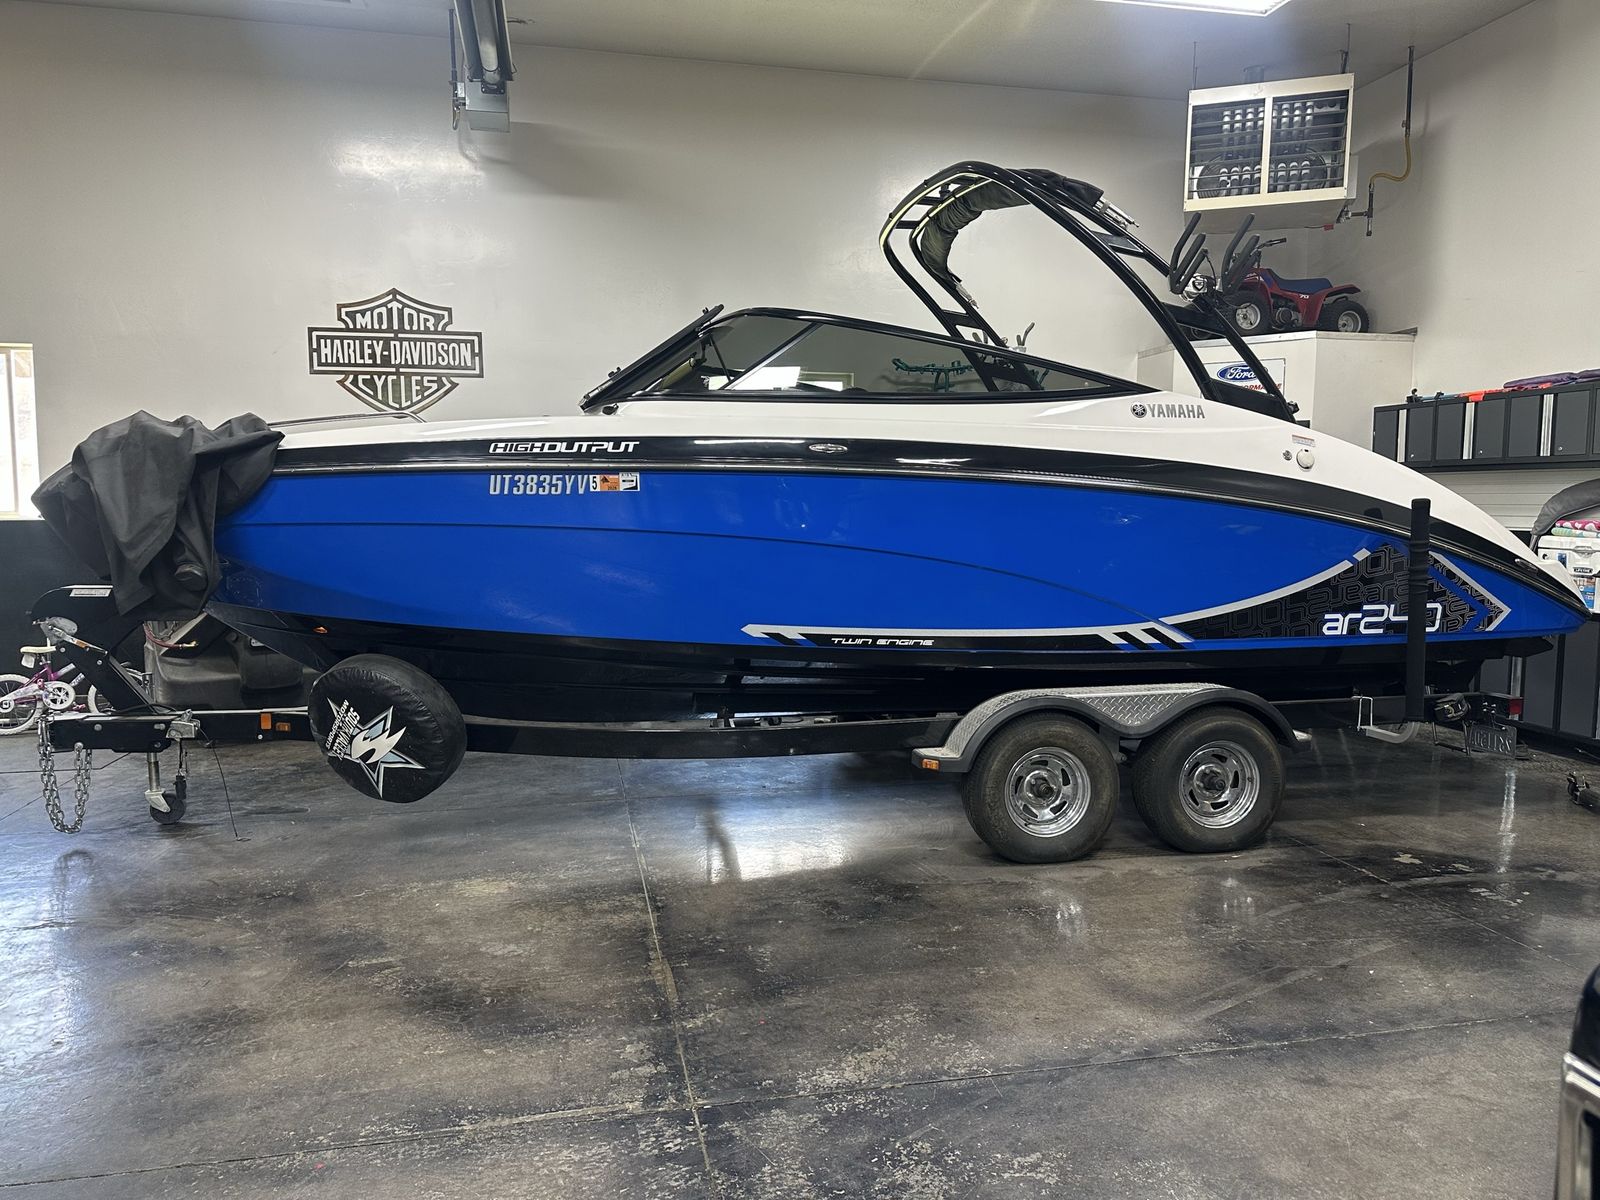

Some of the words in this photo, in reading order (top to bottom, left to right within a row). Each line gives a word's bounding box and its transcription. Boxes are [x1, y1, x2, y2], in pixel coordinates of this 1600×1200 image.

[355, 301, 435, 331] MOTOR
[320, 338, 472, 367] HARLEY-DAVIDSON
[357, 374, 438, 408] CYCLES
[1149, 403, 1205, 419] YAMAHA
[489, 474, 588, 495] UT3835YV
[591, 475, 598, 490] 5
[876, 638, 935, 646] ENGINE
